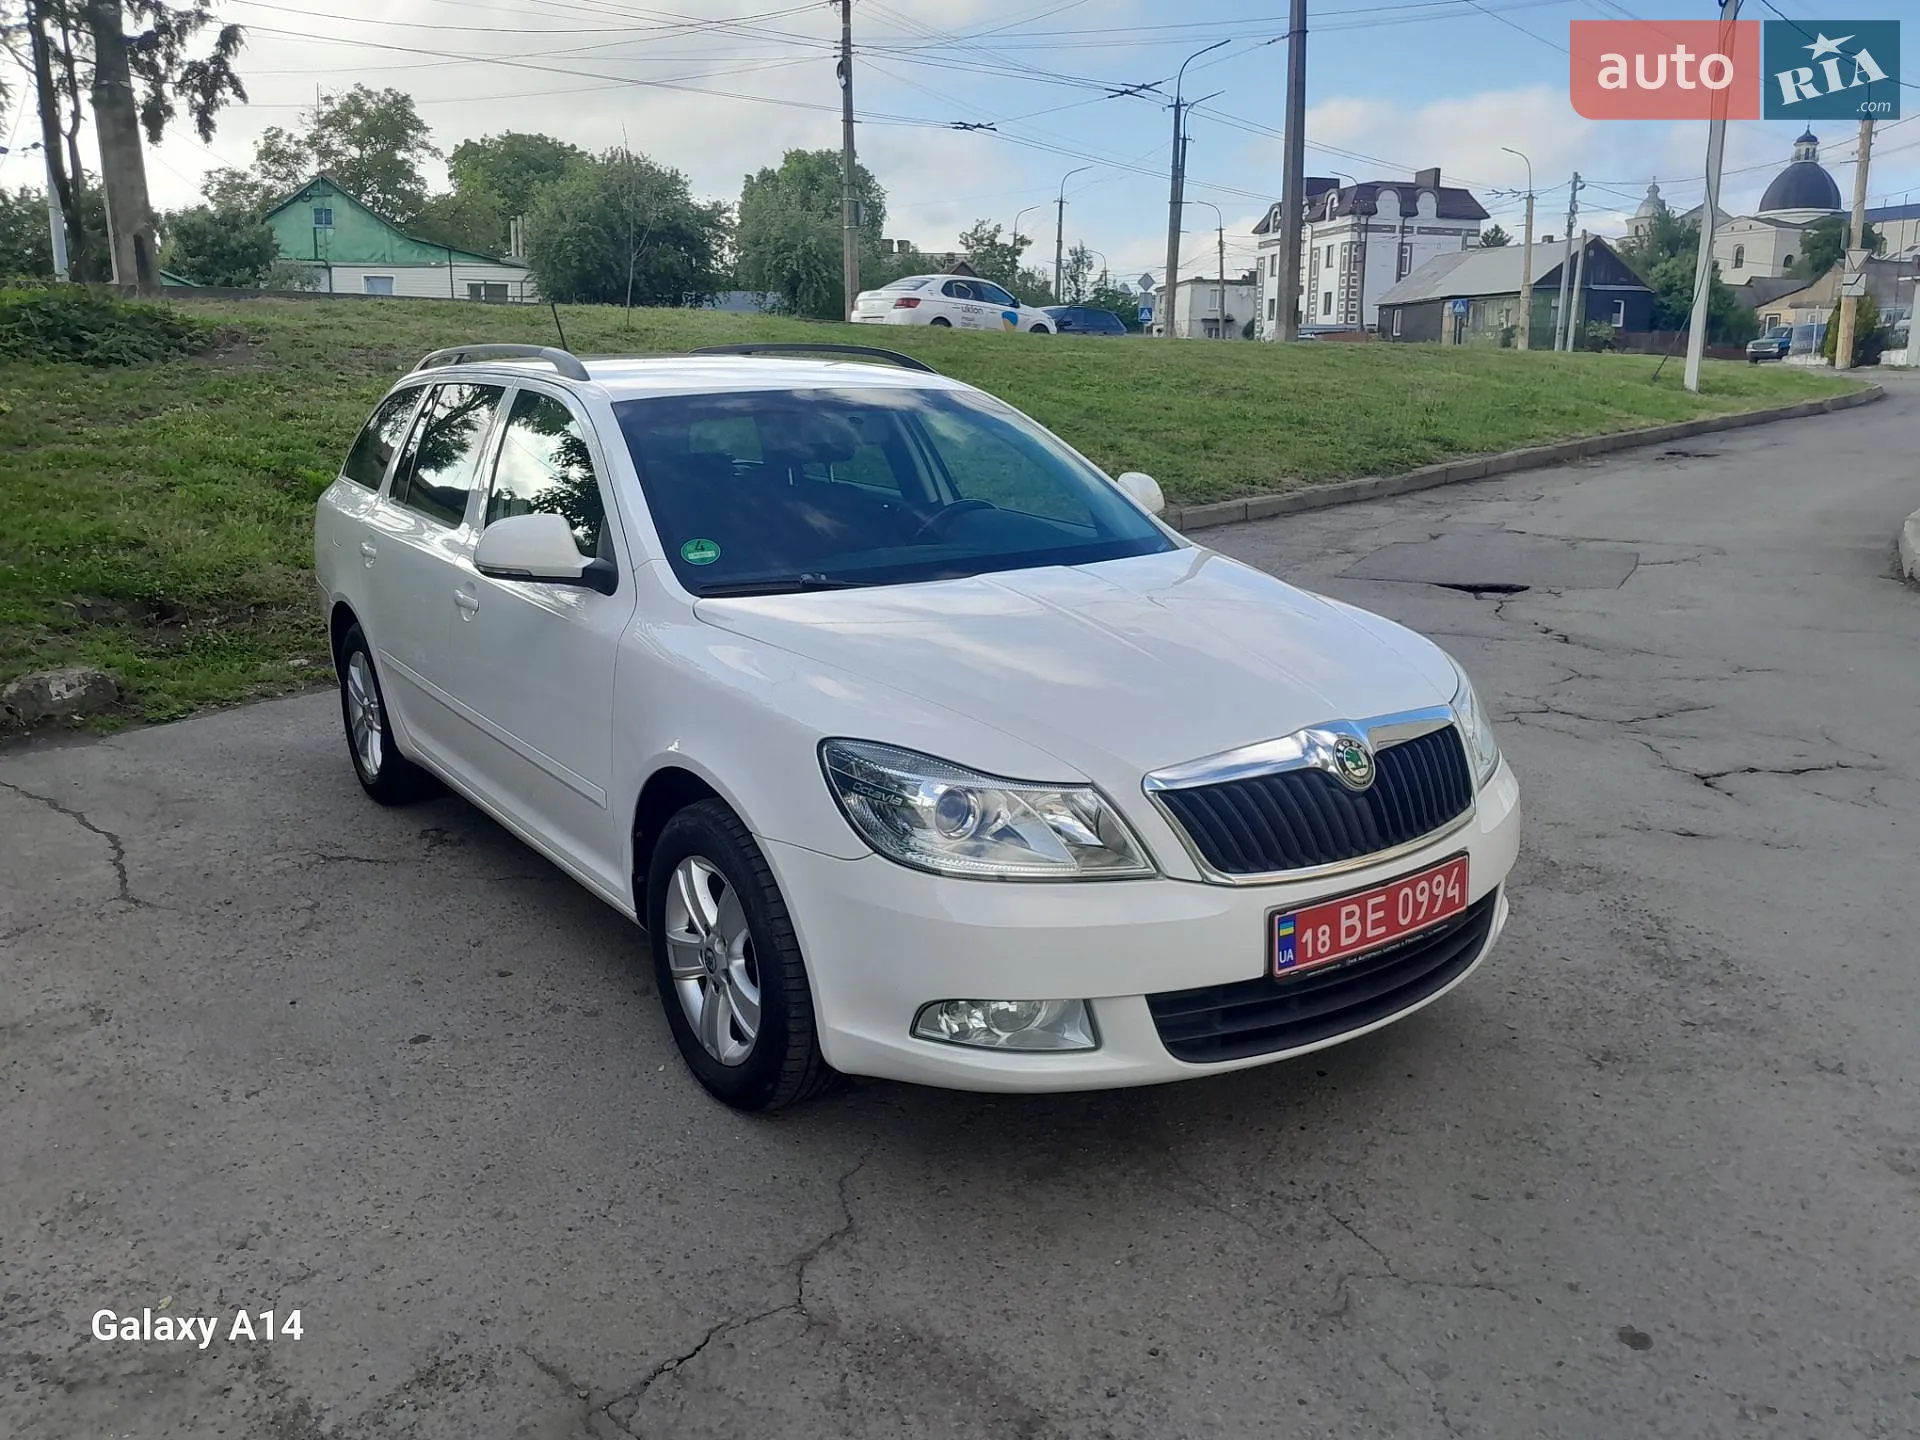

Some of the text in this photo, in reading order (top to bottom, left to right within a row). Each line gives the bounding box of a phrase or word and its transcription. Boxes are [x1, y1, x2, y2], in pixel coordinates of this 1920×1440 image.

[1301, 867, 1460, 958] 18 BE 0994
[1279, 948, 1294, 964] UA
